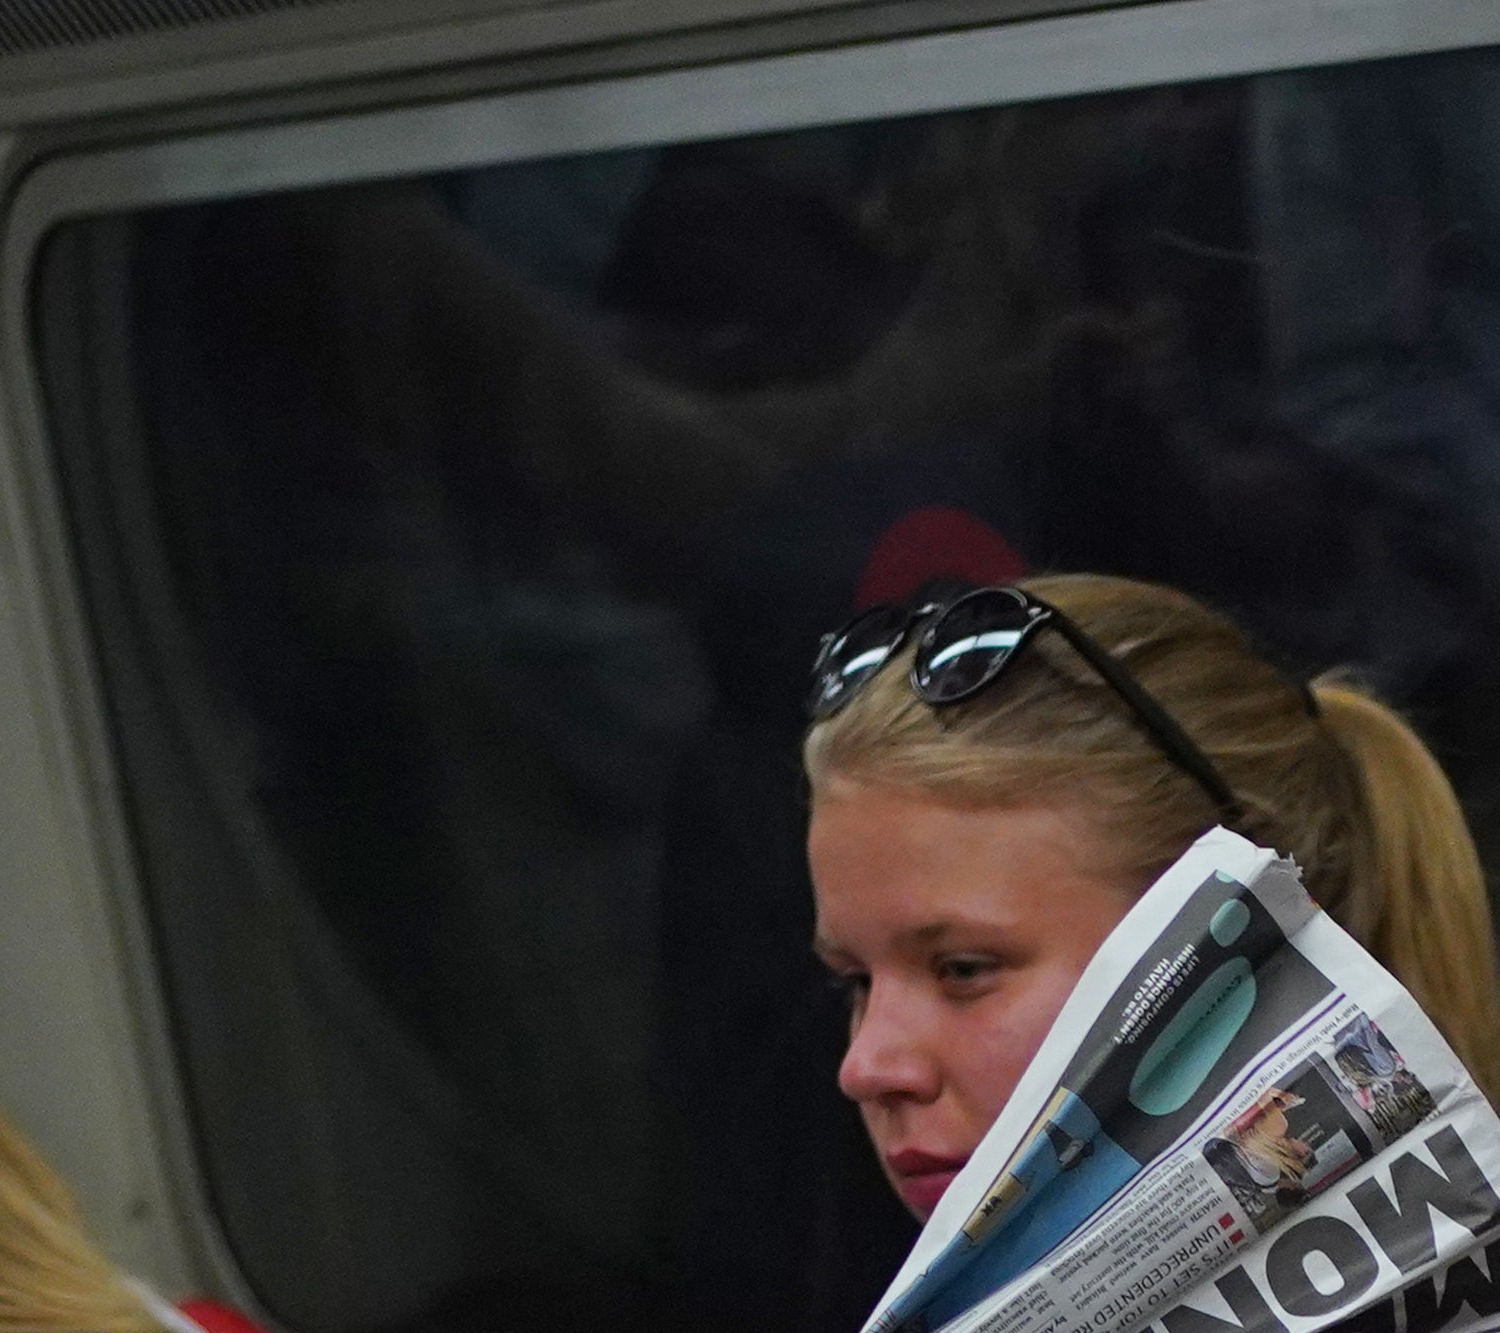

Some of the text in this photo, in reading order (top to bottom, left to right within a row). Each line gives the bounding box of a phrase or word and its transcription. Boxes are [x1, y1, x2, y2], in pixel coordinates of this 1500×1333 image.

[1143, 956, 1170, 987] HAVE
[1145, 942, 1196, 1002] INSURANCE
[1132, 984, 1148, 1001] TO
[1146, 1180, 1168, 1201] there
[1189, 1195, 1222, 1223] HEALTH
[1130, 1225, 1148, 1242] first
[1146, 1215, 1161, 1229] the
[1080, 1240, 1110, 1266] packed
[1111, 1255, 1127, 1269] the
[1124, 1241, 1144, 1259] with
[1200, 1239, 1231, 1267] IT'S
[1091, 1222, 1221, 1327] UNPRECEDENTED
[1108, 1261, 1138, 1285] warned
[1171, 1263, 1200, 1290] SET
[1145, 1286, 1169, 1308] TO
[1053, 1314, 1067, 1327] by
[1112, 1305, 1143, 1333] TOP
